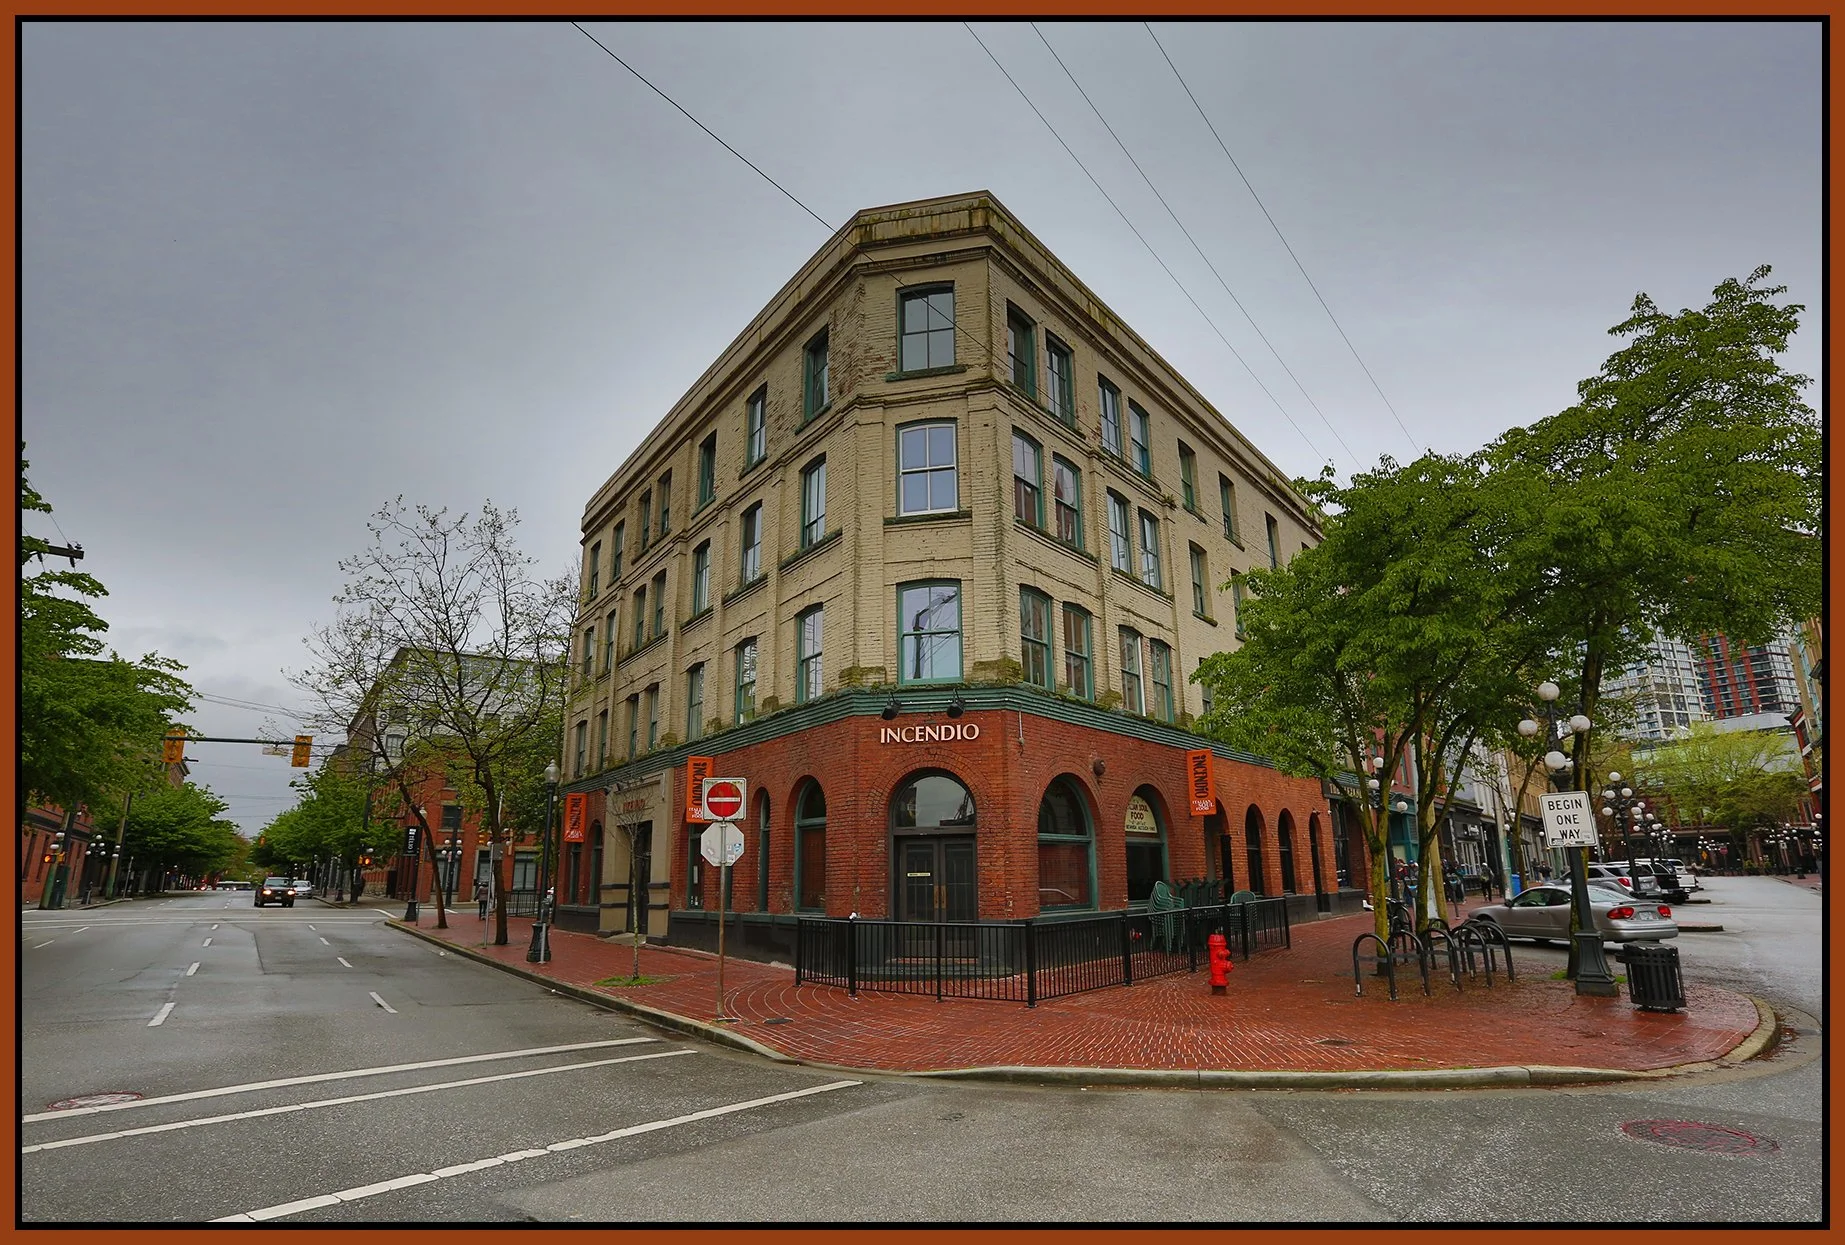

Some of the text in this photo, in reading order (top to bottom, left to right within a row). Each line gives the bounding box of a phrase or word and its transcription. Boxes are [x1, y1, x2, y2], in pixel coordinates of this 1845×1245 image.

[880, 723, 980, 743] INCENDIO
[1547, 799, 1582, 810] BEGIN
[1130, 811, 1145, 820] FOOD
[1556, 814, 1580, 825] ONE
[1559, 829, 1580, 839] WAY
